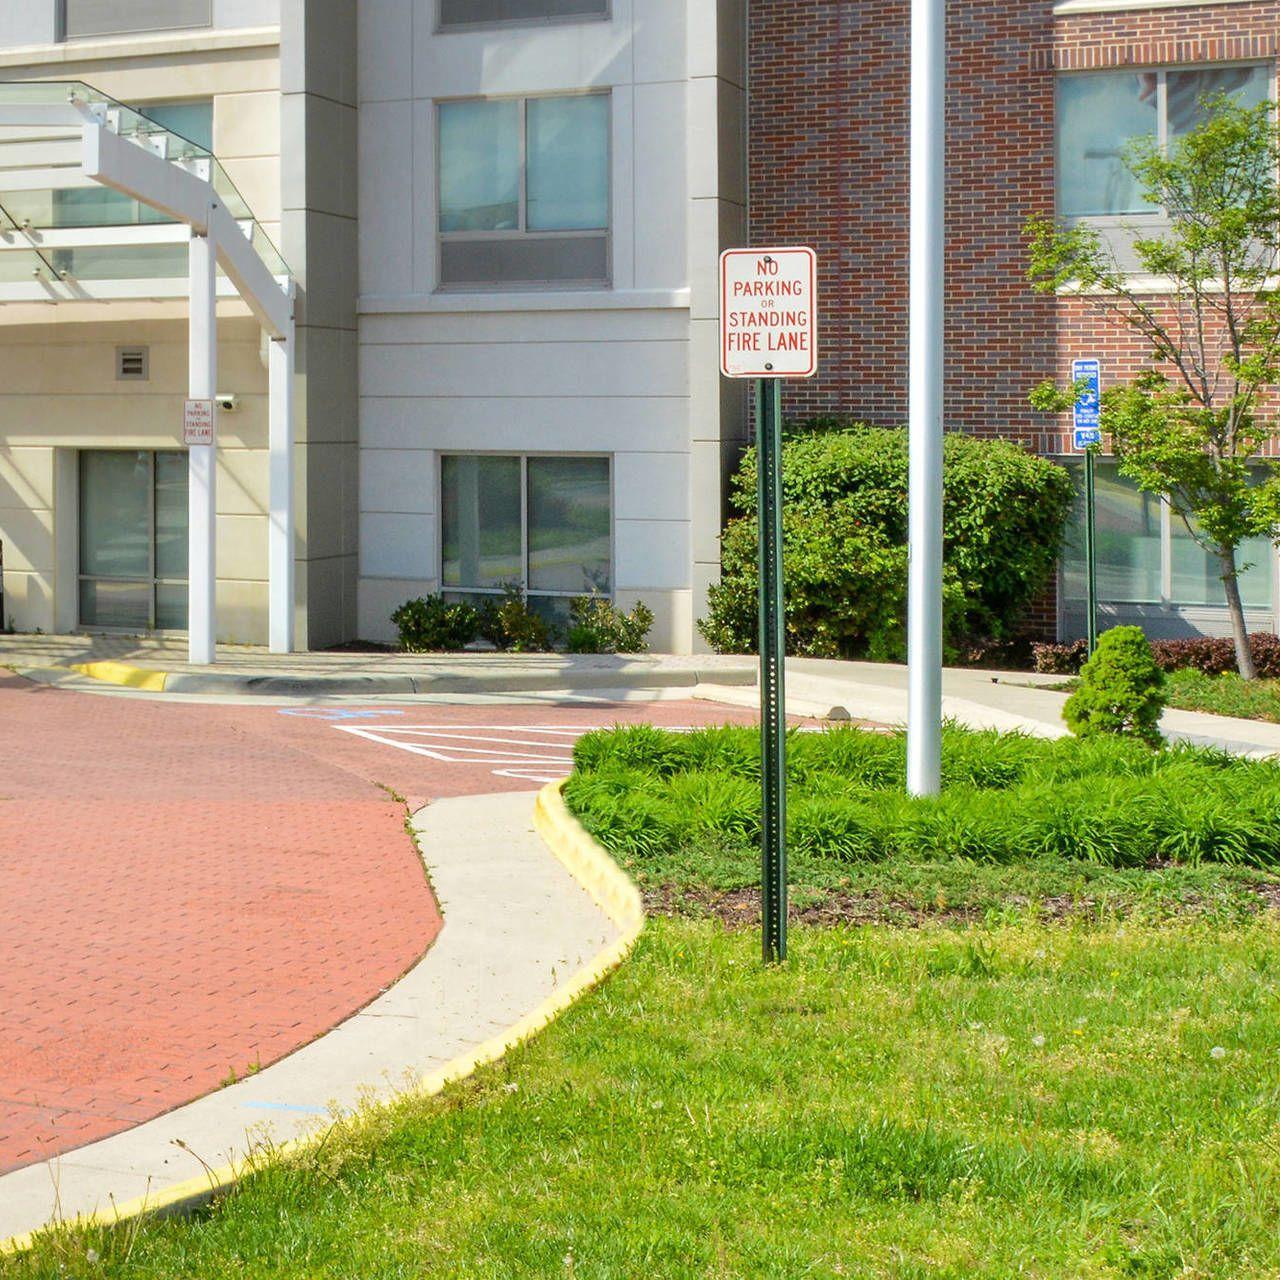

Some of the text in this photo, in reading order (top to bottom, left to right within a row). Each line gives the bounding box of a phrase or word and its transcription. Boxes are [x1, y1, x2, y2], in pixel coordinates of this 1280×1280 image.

[757, 260, 778, 275] NO
[734, 280, 802, 296] PARKING
[761, 299, 775, 308] OR
[729, 311, 807, 327] STANDING
[728, 332, 808, 351] FIRE LANE
